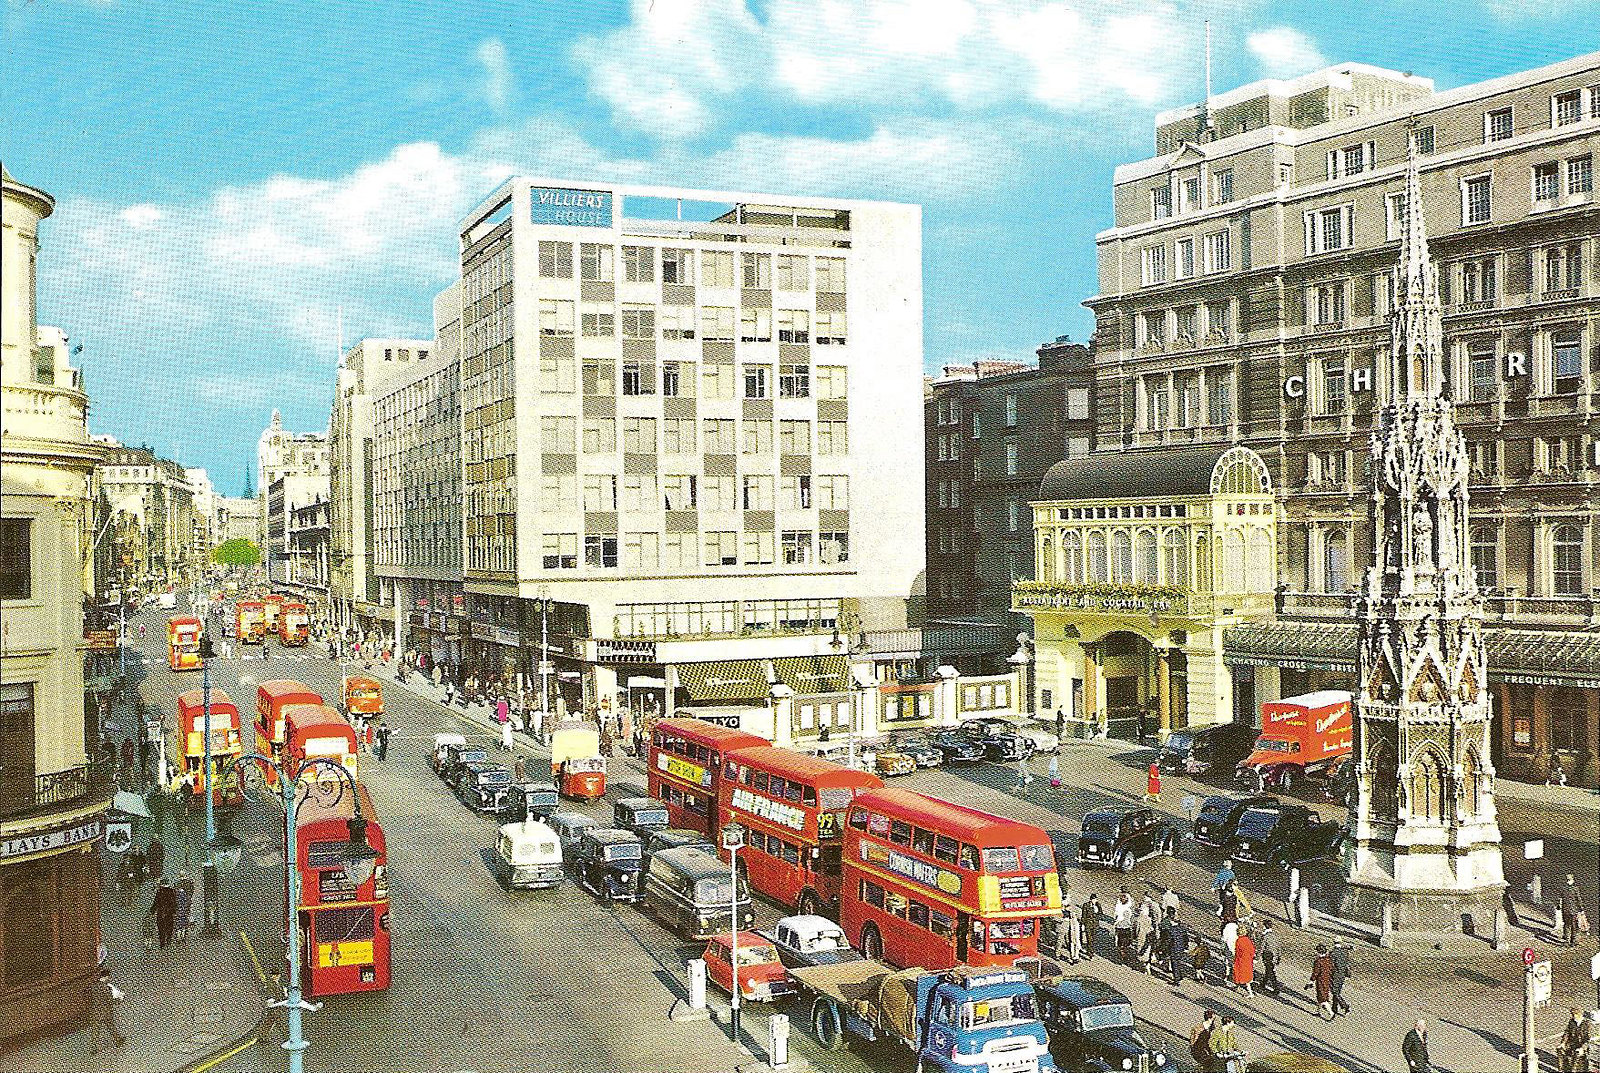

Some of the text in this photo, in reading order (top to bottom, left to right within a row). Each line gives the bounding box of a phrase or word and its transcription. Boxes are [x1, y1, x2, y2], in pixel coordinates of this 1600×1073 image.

[539, 192, 604, 208] VILLIERS
[555, 210, 603, 224] HOUSE
[1277, 660, 1307, 669] CROSS
[1504, 674, 1564, 686] FREQUENT
[731, 788, 806, 831] AIR FRANCE
[816, 812, 835, 829] 99
[0, 822, 99, 855] LAYS BANK
